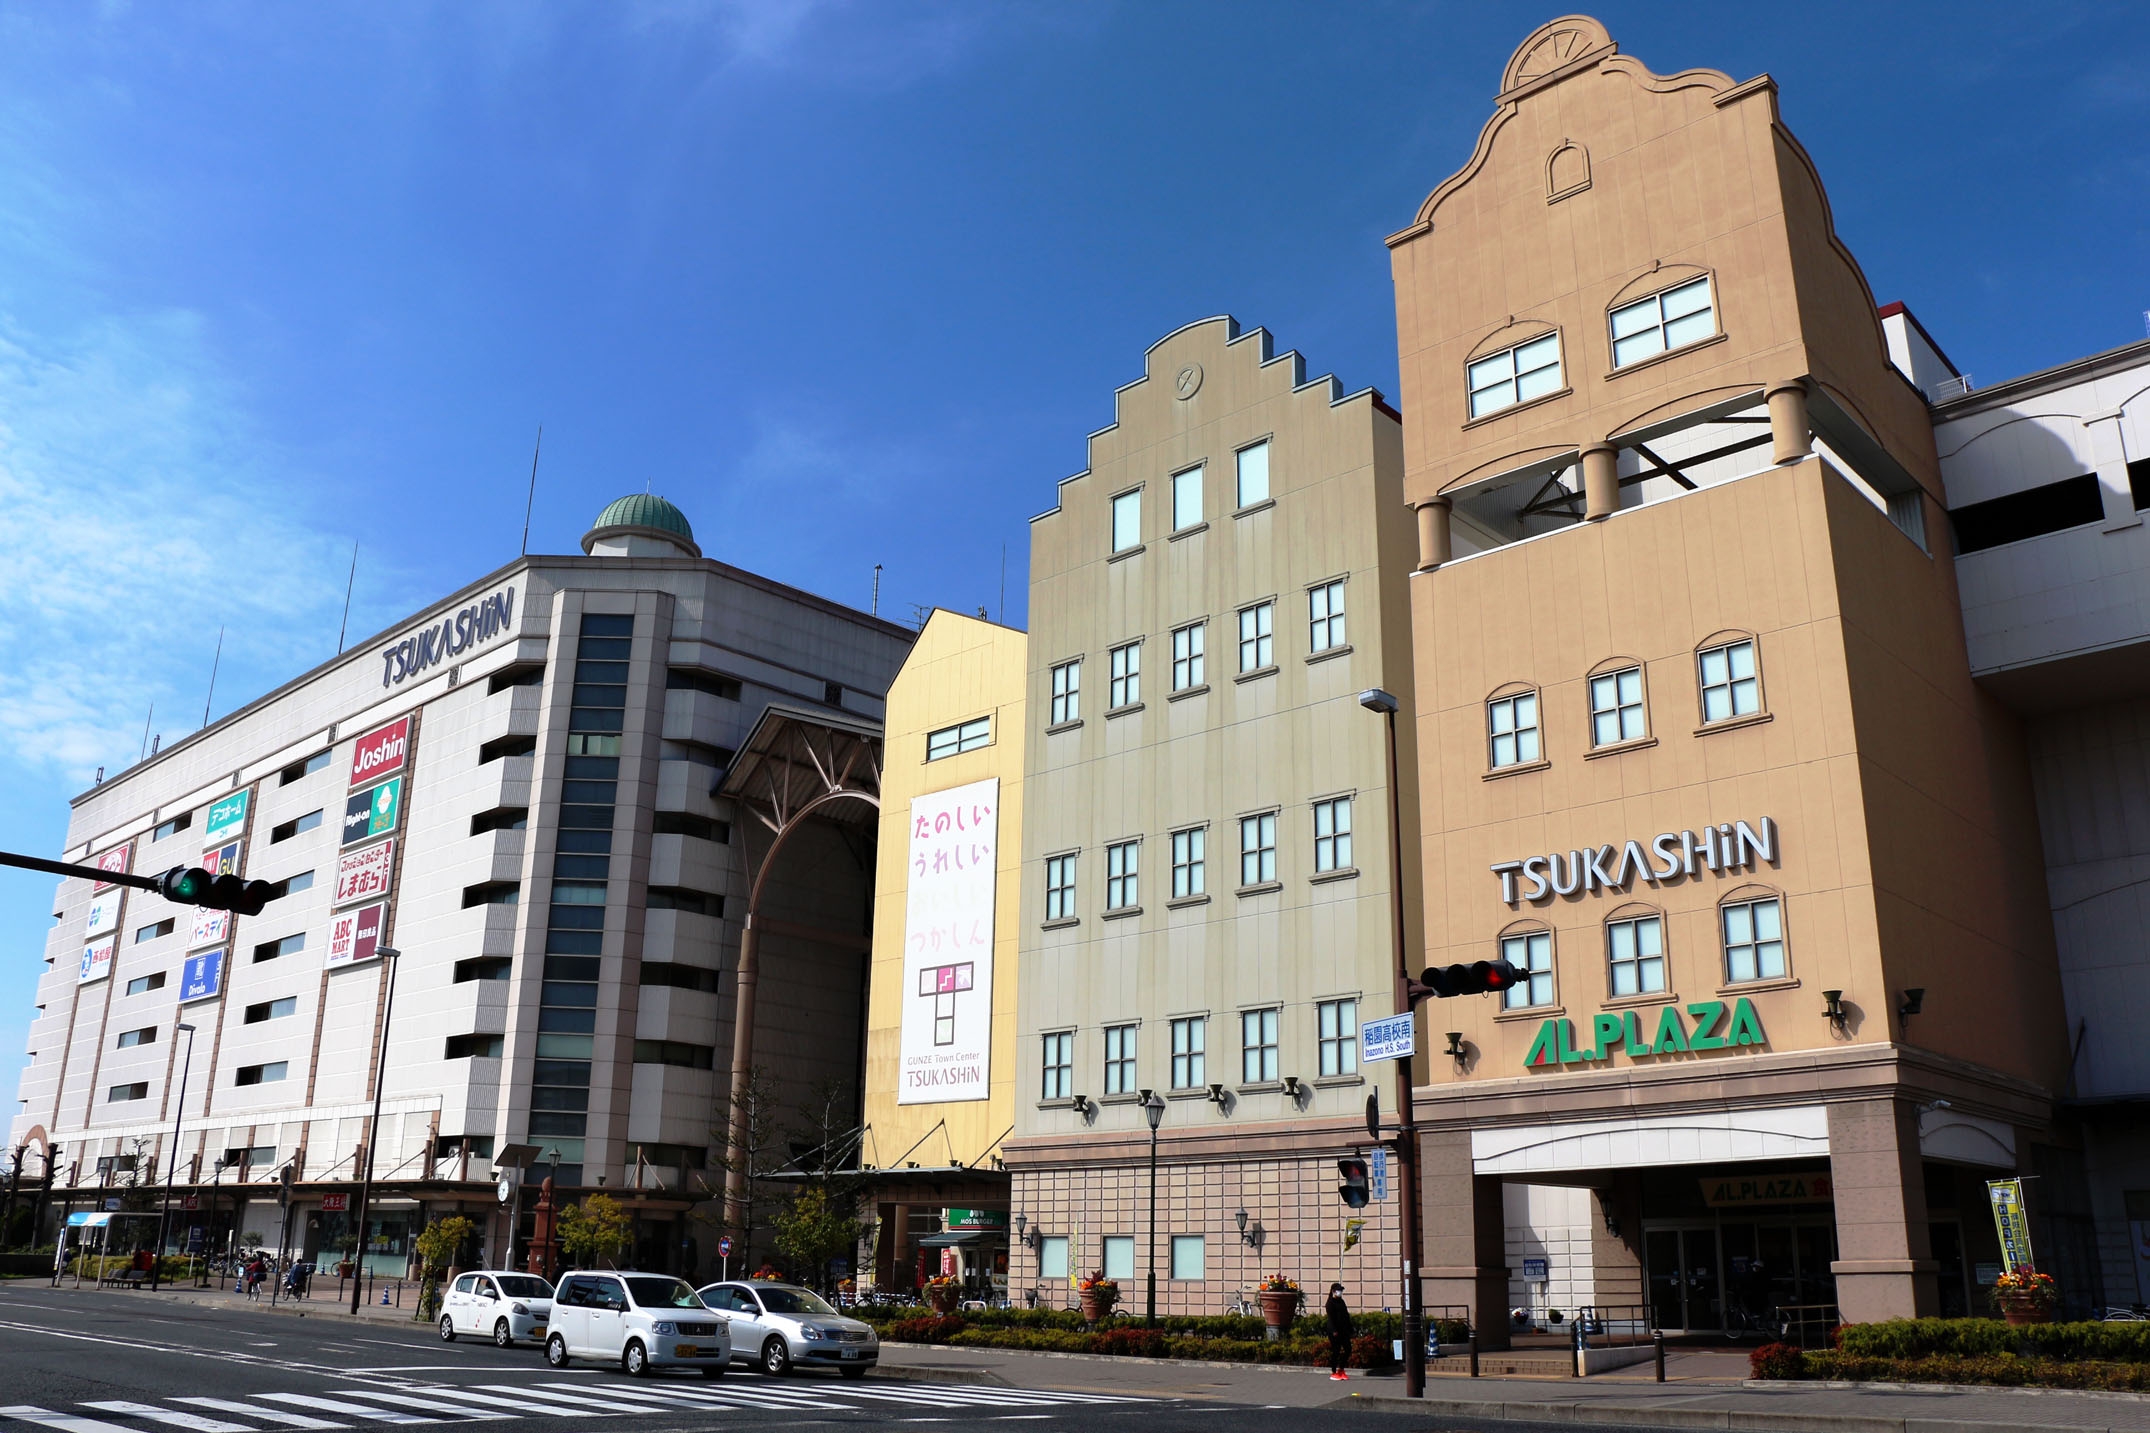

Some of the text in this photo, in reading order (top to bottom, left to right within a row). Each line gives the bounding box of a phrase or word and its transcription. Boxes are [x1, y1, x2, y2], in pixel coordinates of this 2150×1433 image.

[353, 734, 405, 774] Joshin
[211, 799, 242, 827] デコホーム
[914, 804, 991, 840] たのしい
[219, 855, 235, 876] GU
[341, 849, 384, 872] ファッションセンター
[914, 843, 990, 878] うれしい
[337, 865, 382, 900] しまむら
[190, 918, 223, 943] バースデイ
[333, 918, 353, 941] ABC
[910, 919, 985, 953] つかしん
[92, 945, 112, 964] 西松屋
[331, 938, 351, 954] MART
[188, 981, 206, 996] Divalo
[1364, 1020, 1411, 1046] 稲園高校南
[1523, 997, 1766, 1067] AL.PLAZA
[907, 1052, 980, 1066] GUNZE Town Center
[1365, 1040, 1411, 1058] Inazono H.S. South
[1712, 1179, 1808, 1201] AL.PLAZA
